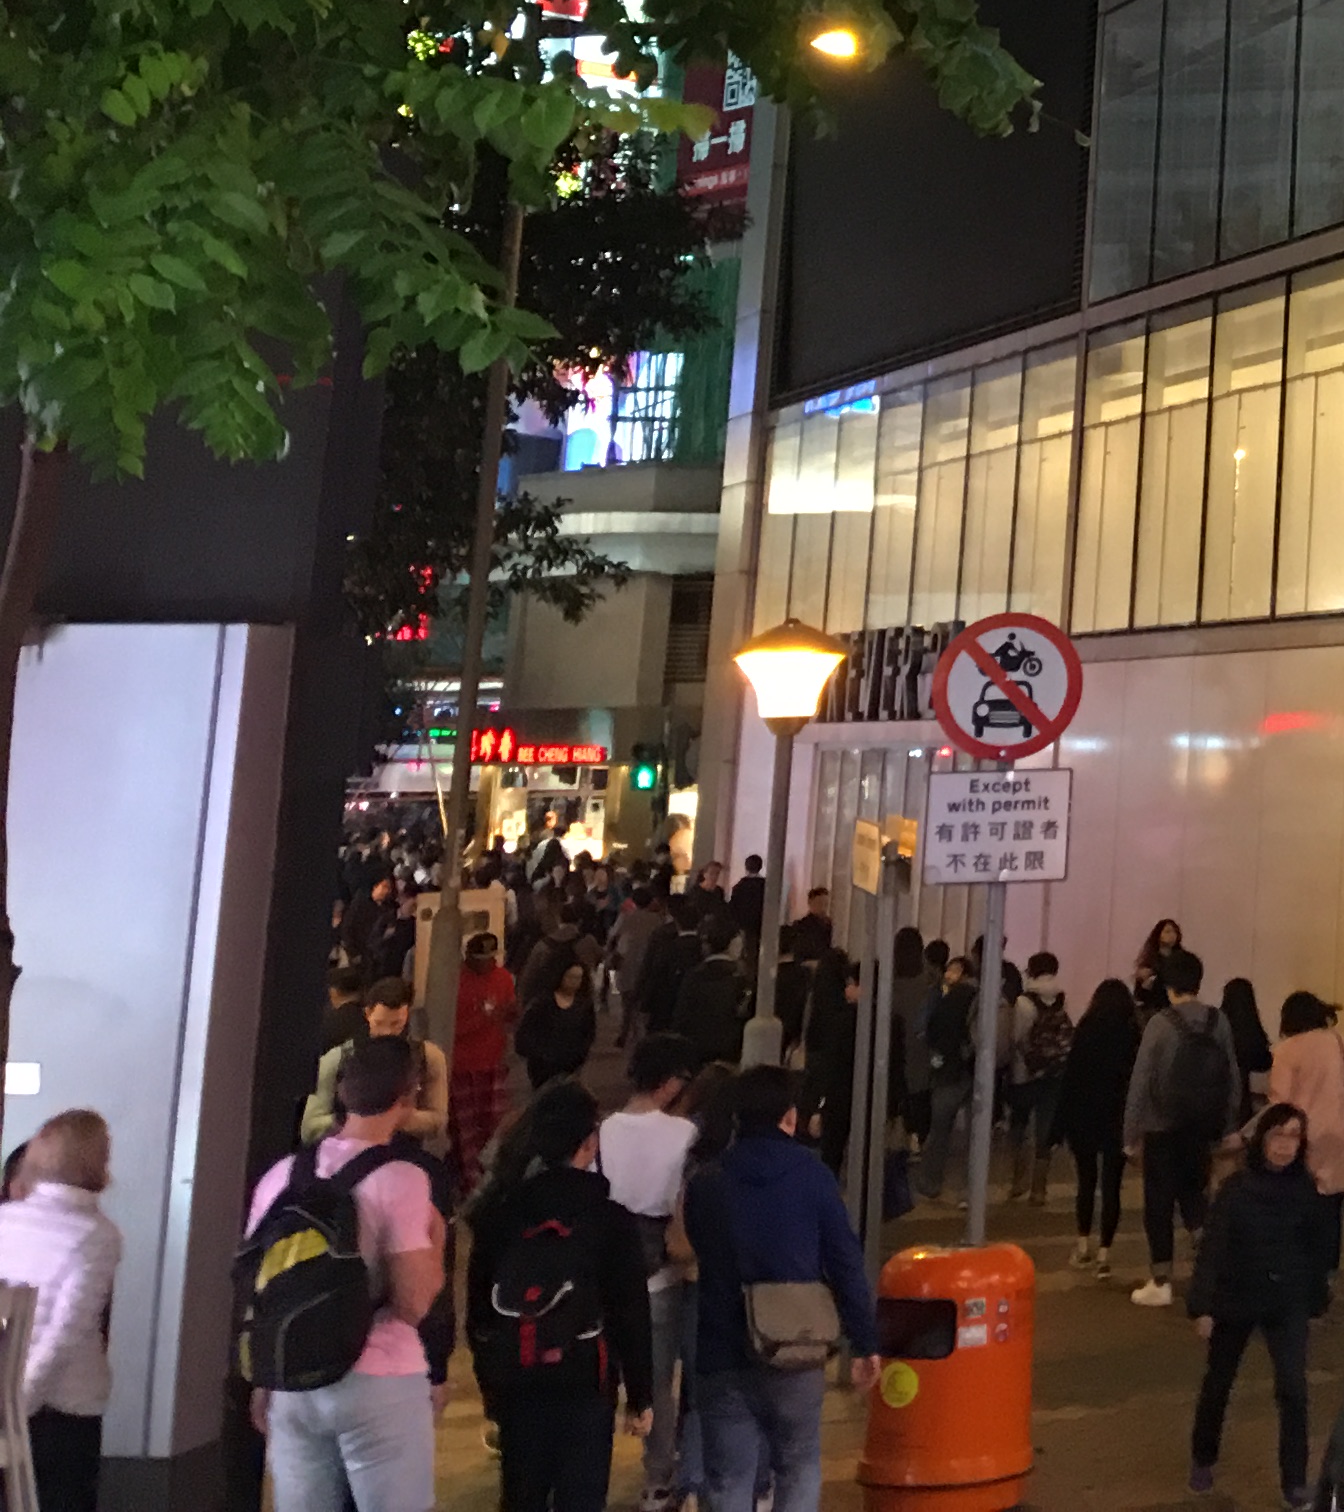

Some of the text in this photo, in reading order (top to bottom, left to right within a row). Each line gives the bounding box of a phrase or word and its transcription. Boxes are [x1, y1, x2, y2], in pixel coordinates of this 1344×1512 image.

[969, 778, 1031, 795] Except
[947, 796, 1050, 813] with permit
[934, 821, 1059, 843] 有許可證者
[946, 851, 1045, 873] 不在此限
